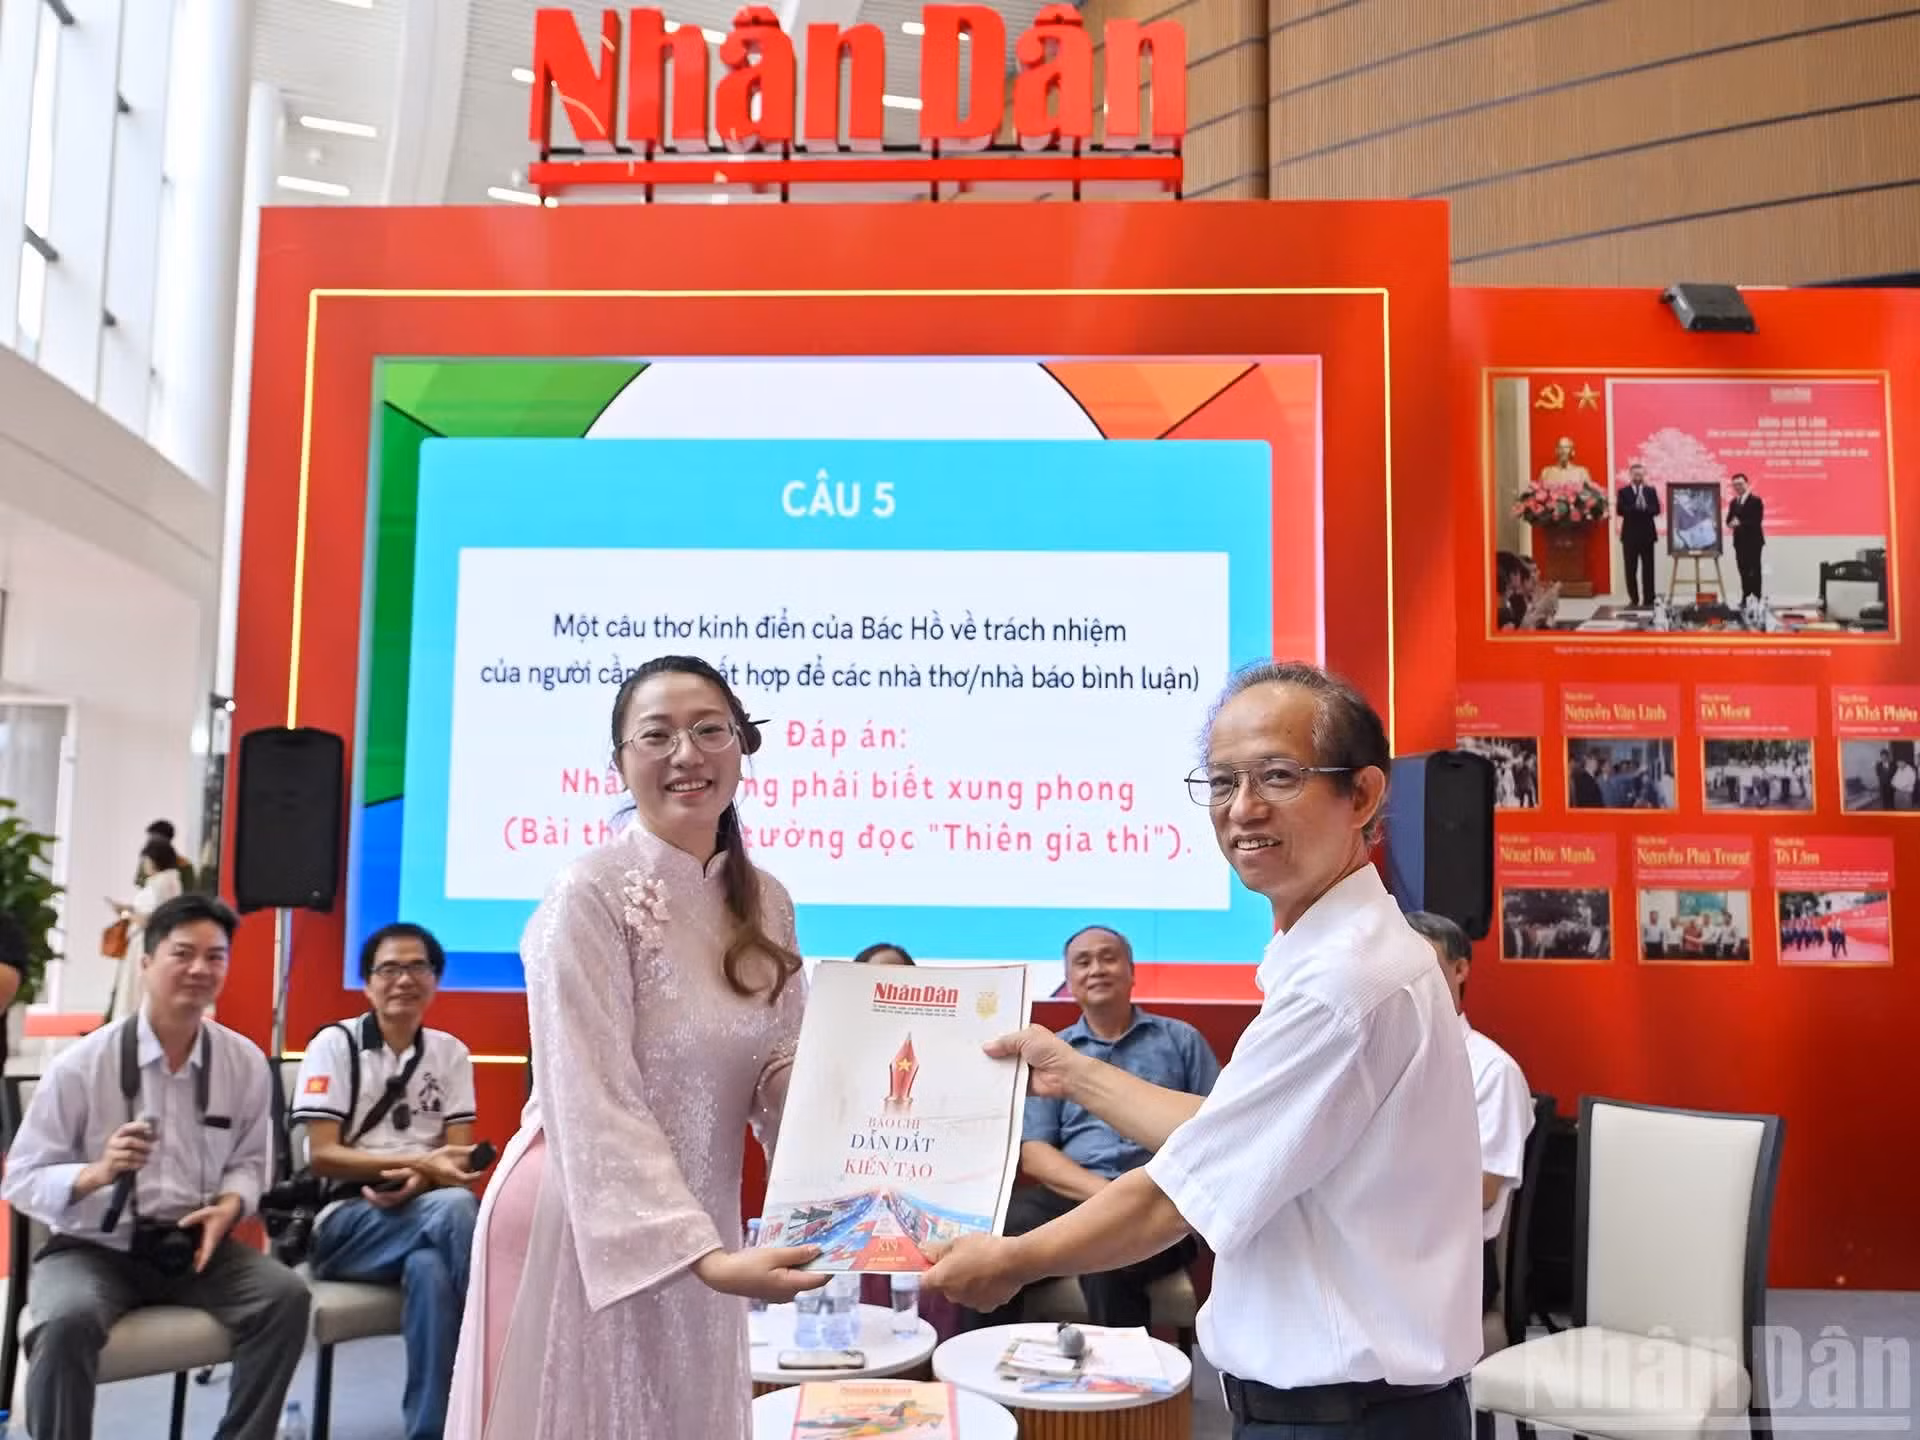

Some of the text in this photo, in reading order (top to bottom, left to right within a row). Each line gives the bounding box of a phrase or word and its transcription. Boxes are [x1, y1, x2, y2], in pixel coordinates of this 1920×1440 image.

[529, 3, 1187, 146] Nhân Dân
[782, 467, 897, 518] CÂU 5
[554, 608, 1127, 647] Một câu thơ kinh điển của Bác Hồ về trách nhiệm
[480, 658, 521, 683] của
[529, 664, 591, 691] người
[746, 663, 790, 692] hợp
[797, 654, 826, 686] để
[832, 662, 871, 687] các
[879, 664, 921, 688] nhà
[929, 664, 1024, 695] thơ/nhà
[1032, 664, 1075, 689] báo
[1082, 664, 1133, 689] bình
[1141, 664, 1200, 695] luận)
[786, 718, 906, 757] Đáp án:
[792, 769, 858, 808] phải
[871, 763, 933, 800] biết
[948, 778, 1023, 810] xung
[1036, 774, 1135, 812] phong
[503, 815, 568, 851] (Bài
[583, 817, 614, 846] th
[858, 822, 913, 857] đọc
[930, 821, 1032, 852] "Thiên
[1046, 823, 1093, 862] gia
[844, 1155, 899, 1176] KIẾN
